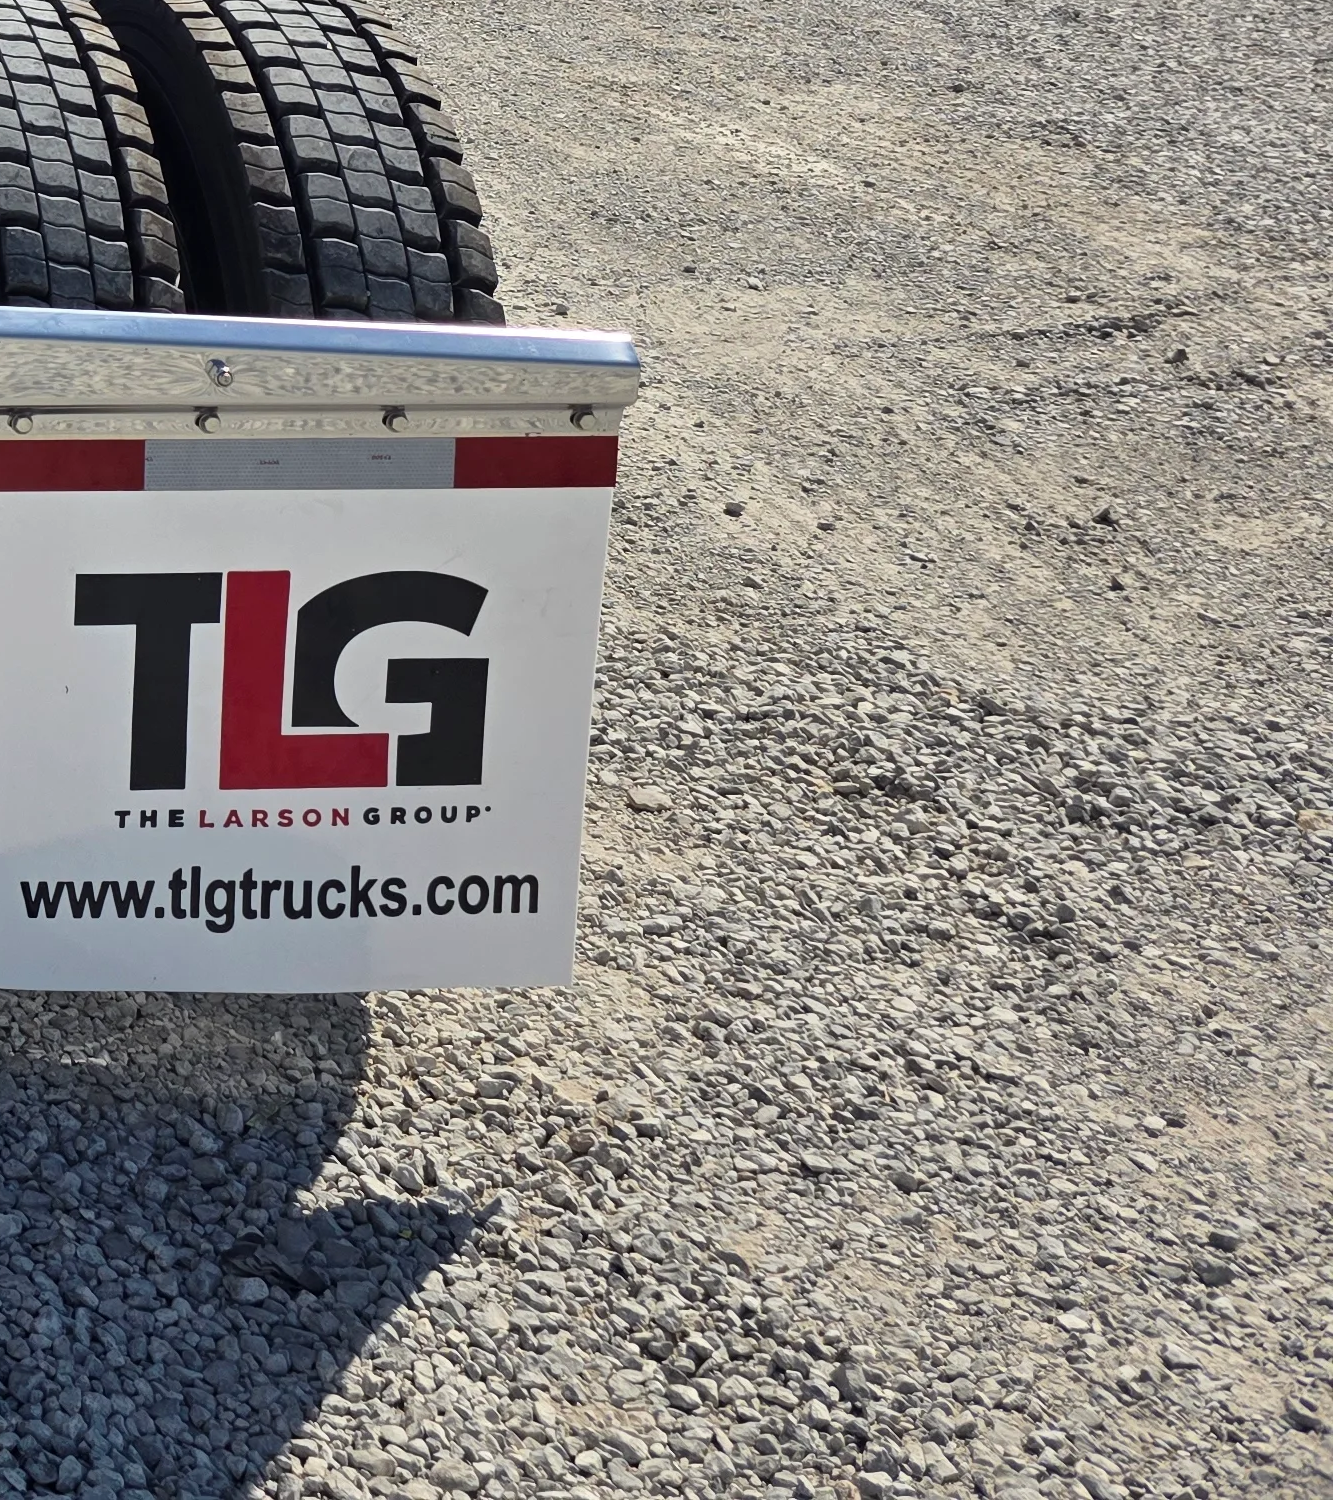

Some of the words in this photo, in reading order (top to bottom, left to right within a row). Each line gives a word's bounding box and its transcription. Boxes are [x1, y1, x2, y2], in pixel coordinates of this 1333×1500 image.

[73, 569, 490, 792] TLG
[114, 808, 186, 829] THE
[199, 807, 350, 829] LARSON
[362, 805, 482, 826] GROUP
[19, 864, 539, 934] www.tlgtrucks.com
